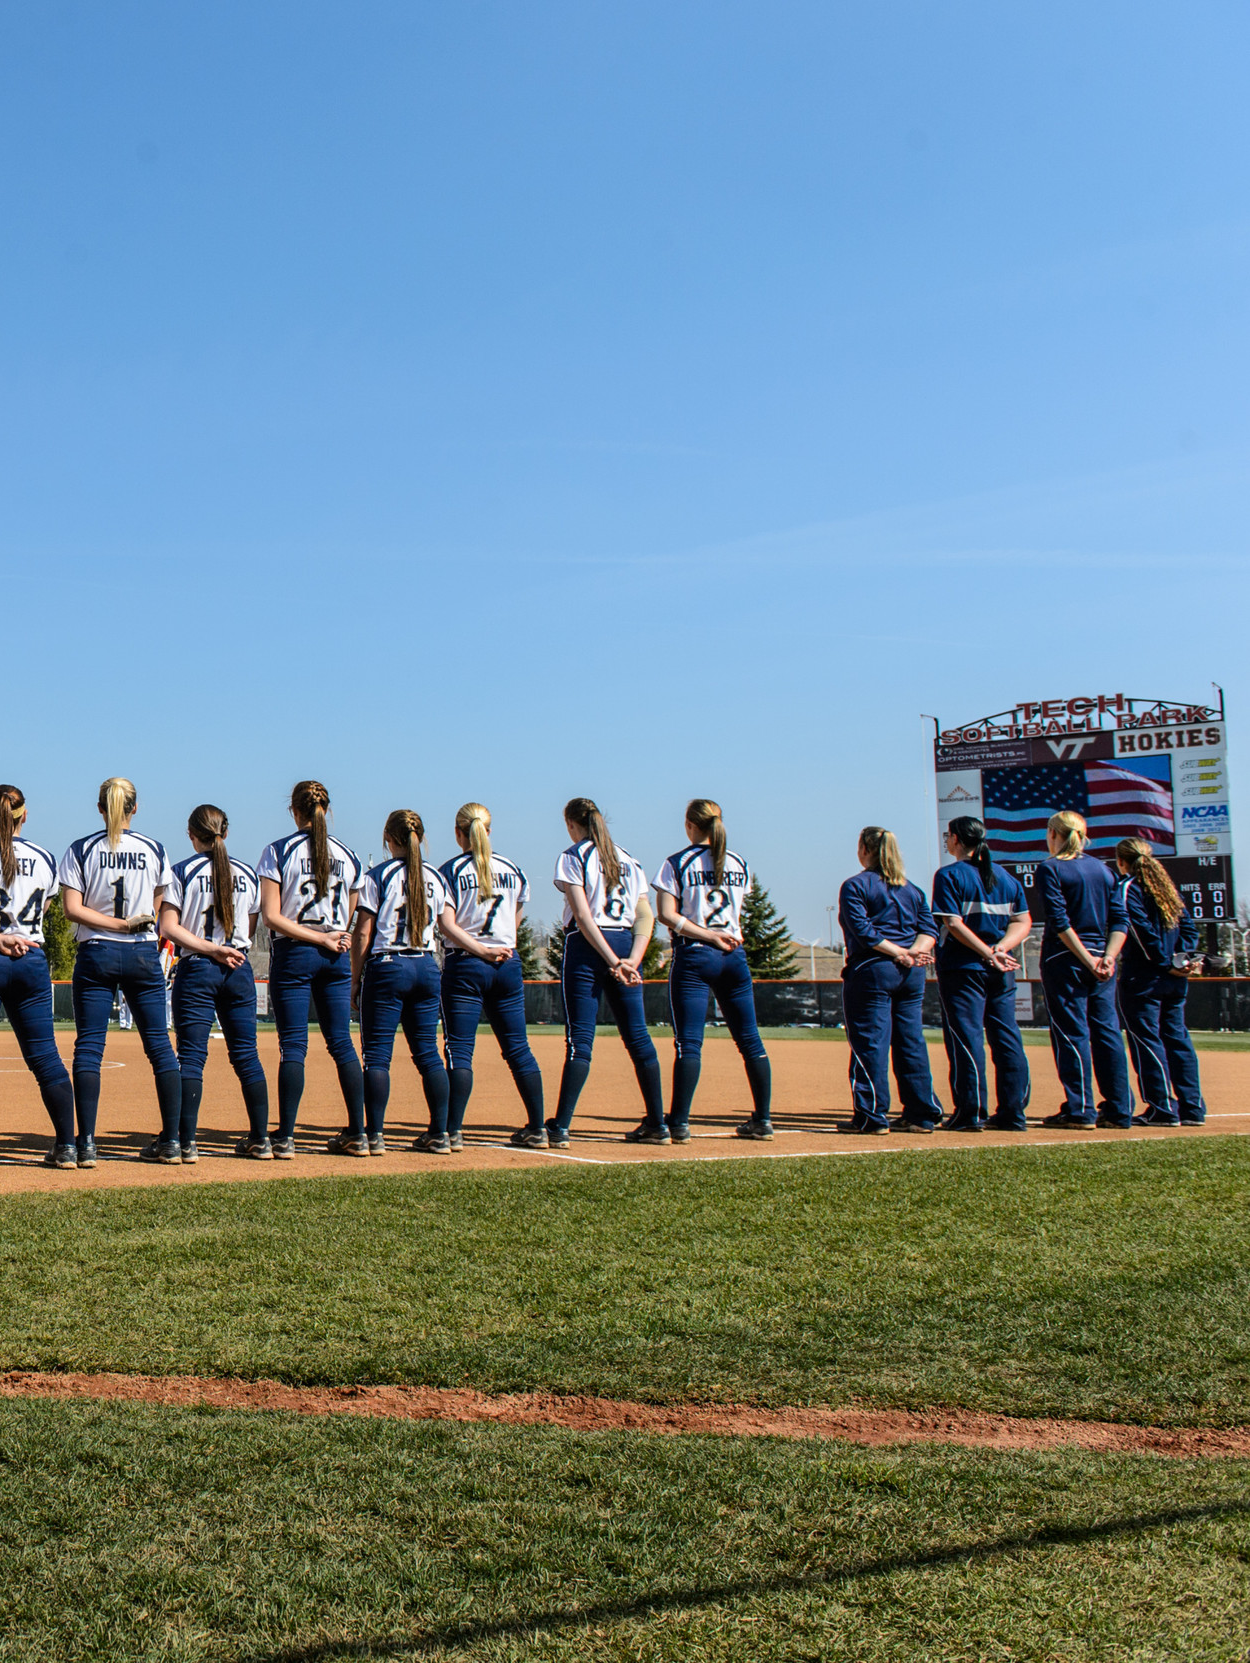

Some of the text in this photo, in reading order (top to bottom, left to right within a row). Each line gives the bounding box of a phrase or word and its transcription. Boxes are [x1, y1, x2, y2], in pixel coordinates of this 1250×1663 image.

[1016, 693, 1125, 721] TECH
[940, 705, 1208, 746] SOFTBALL PARK
[1046, 736, 1097, 760] VT
[1118, 727, 1222, 753] HOKIES
[937, 751, 1016, 763] OPTOMETRISTS
[1181, 804, 1230, 819] NCAA
[100, 850, 146, 870] DOWNS
[1198, 856, 1217, 867] H/E
[197, 875, 246, 893] THAS
[688, 870, 744, 887] LIONBRGER
[1024, 873, 1034, 888] 0
[1181, 882, 1226, 891] HITS ERR
[111, 875, 129, 920] 1
[297, 879, 344, 925] 21
[603, 880, 626, 921] 6
[1192, 890, 1223, 904] 0 0
[478, 894, 504, 937] 7
[705, 888, 731, 928] 2
[1193, 905, 1224, 919] 0 0
